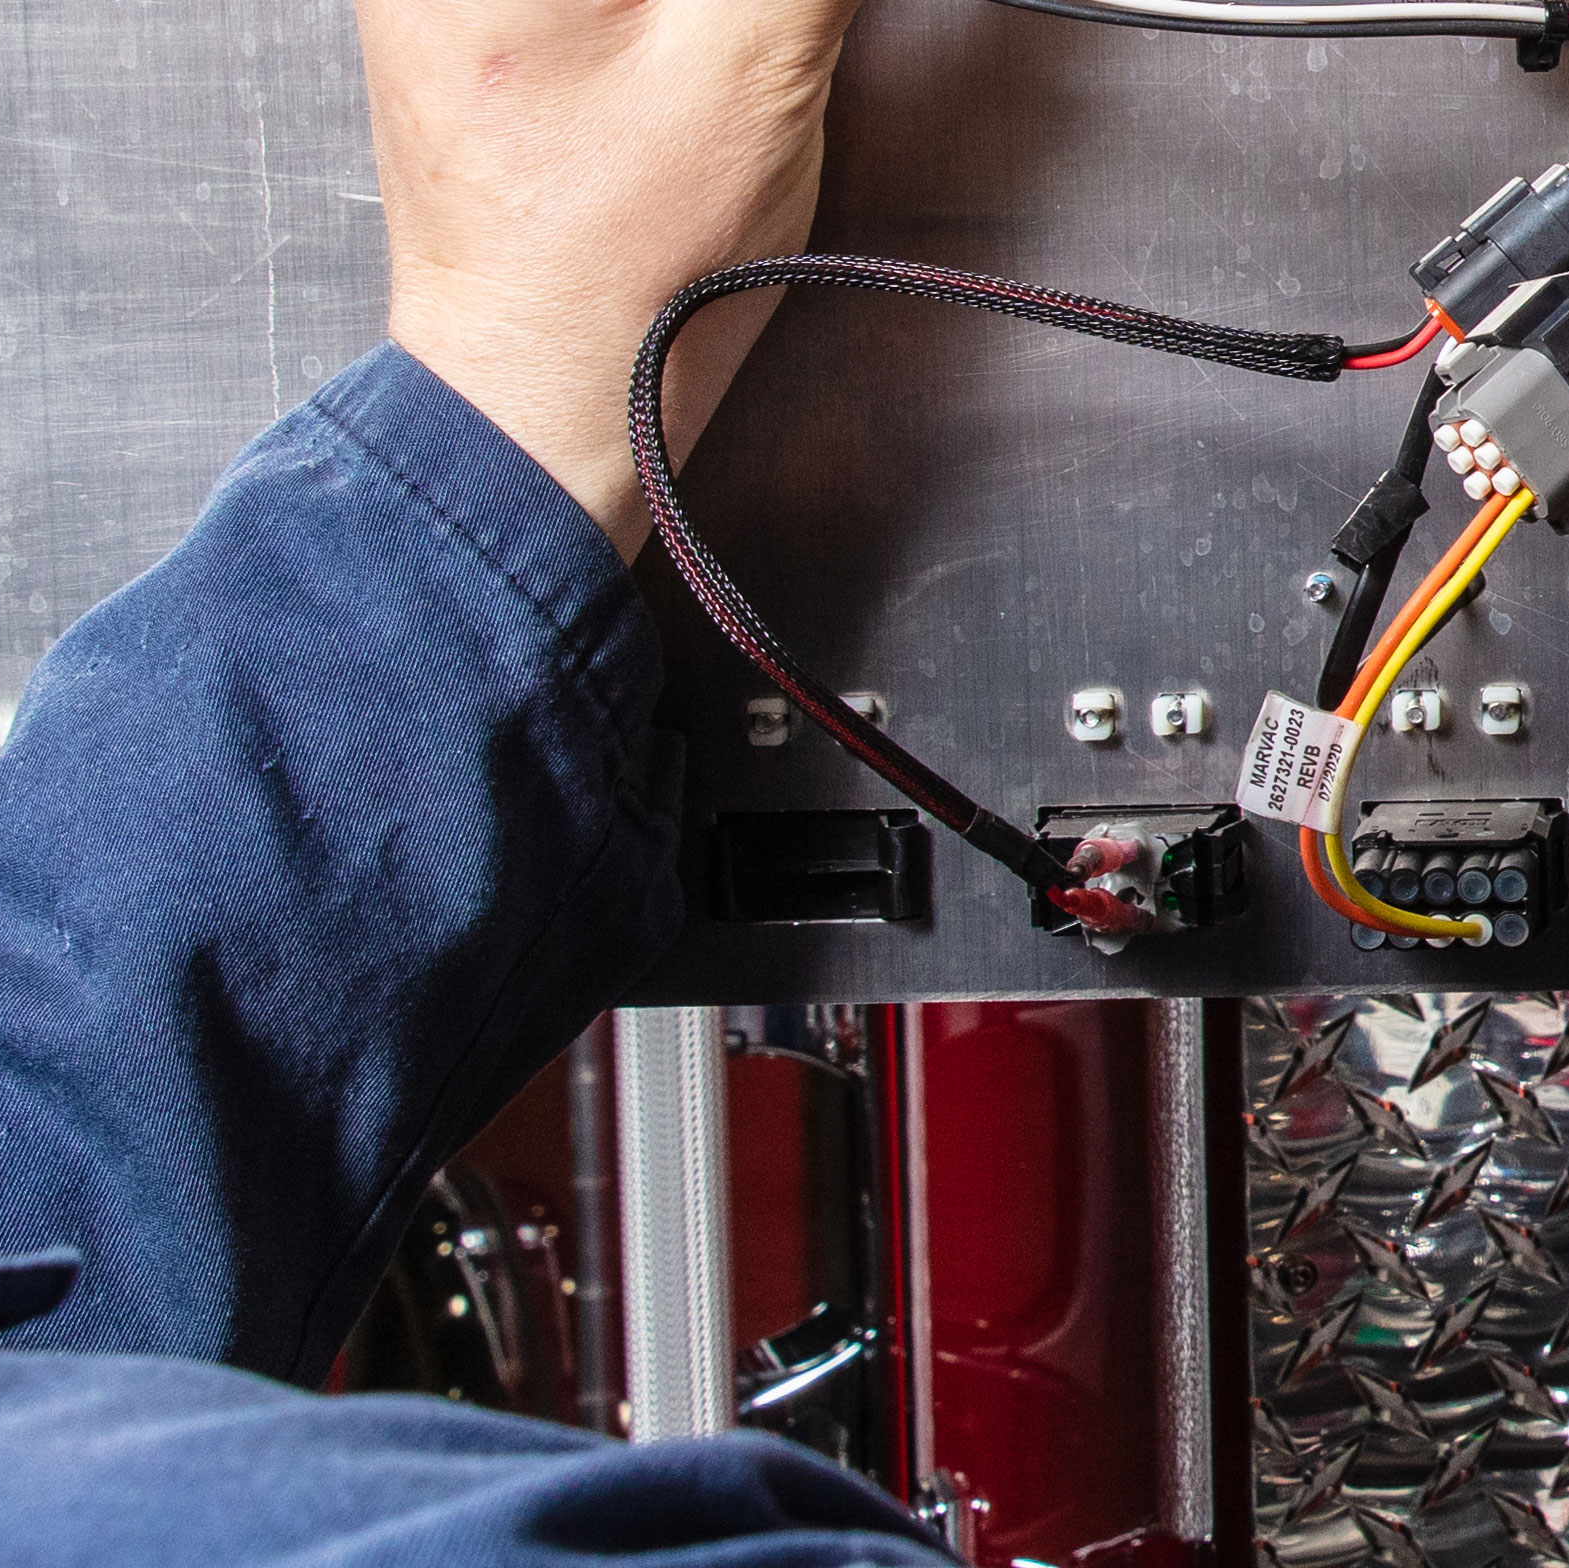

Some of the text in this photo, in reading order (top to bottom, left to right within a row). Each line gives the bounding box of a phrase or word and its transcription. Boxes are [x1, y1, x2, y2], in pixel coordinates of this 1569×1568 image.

[1249, 717, 1280, 789] MARVAC
[1268, 708, 1305, 812] 2627321-0023
[1296, 745, 1321, 790] REVB
